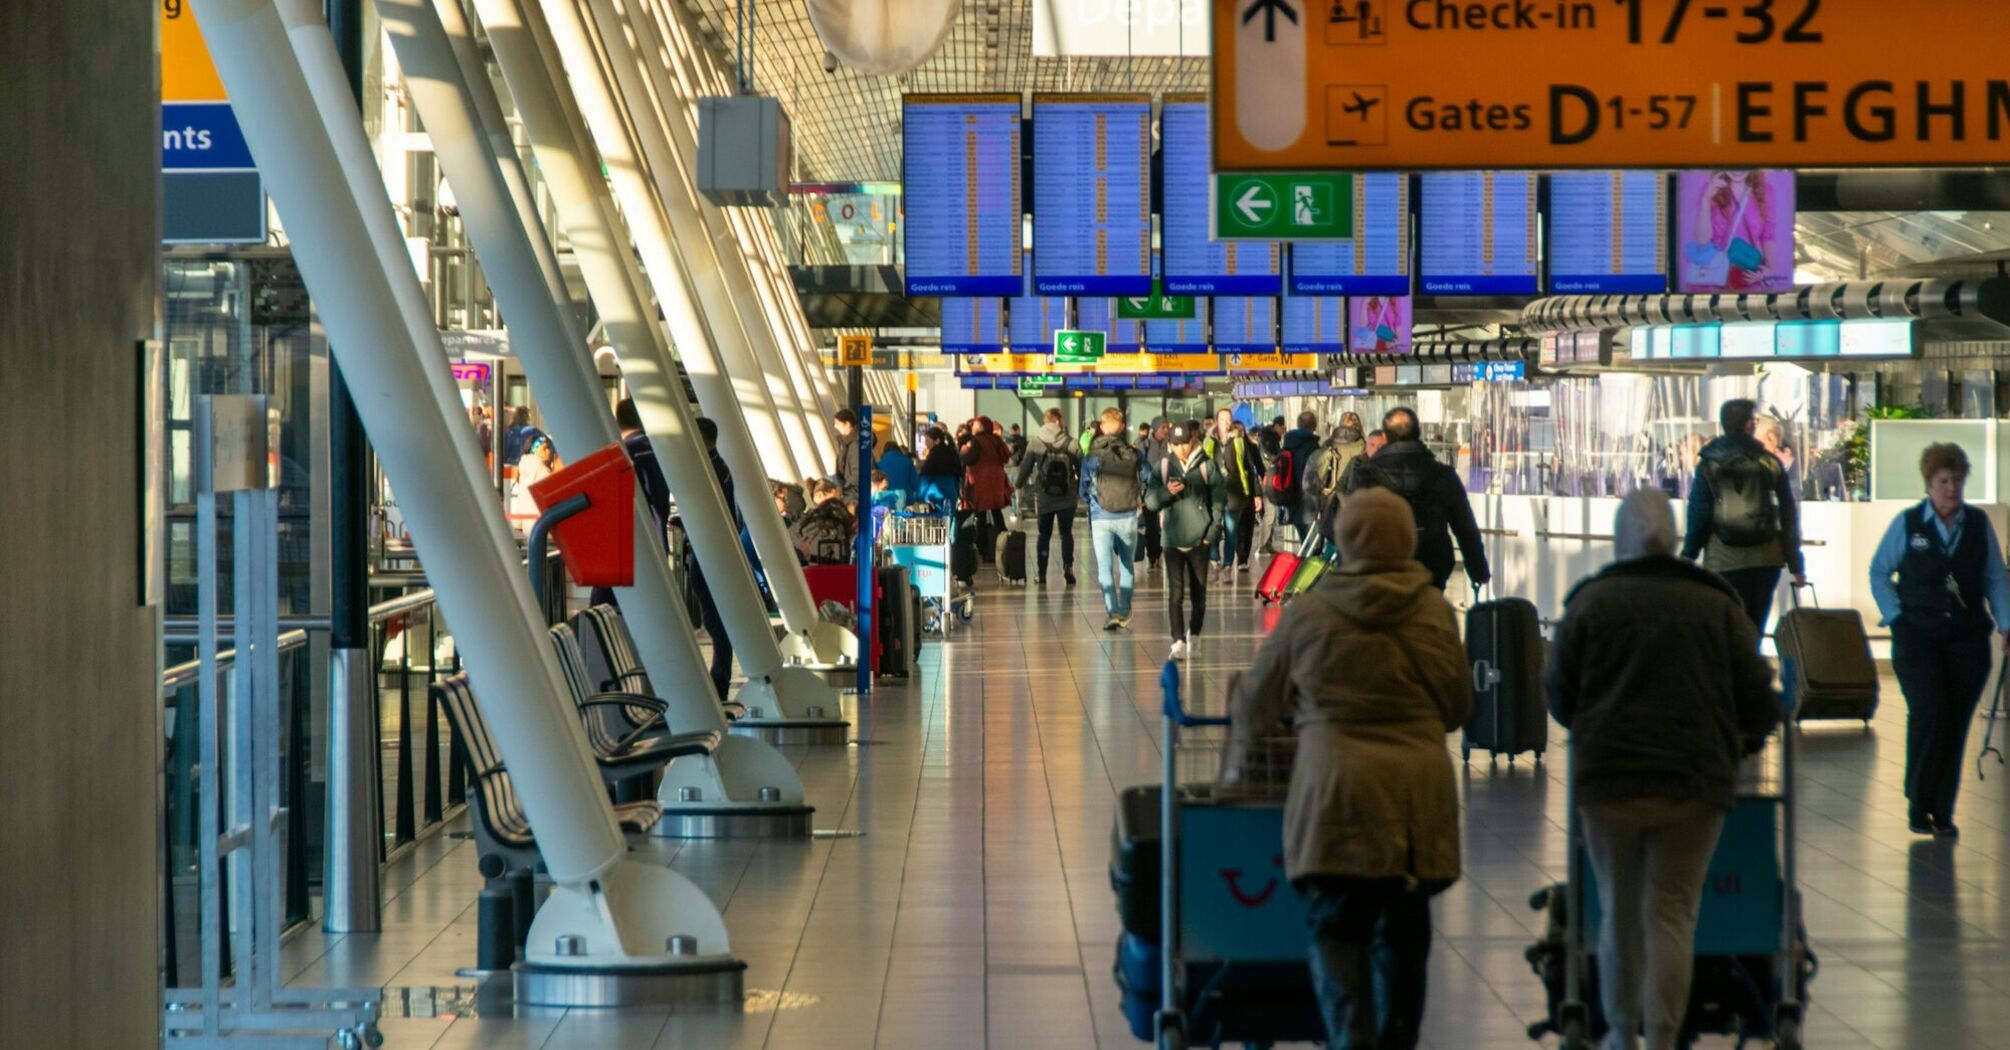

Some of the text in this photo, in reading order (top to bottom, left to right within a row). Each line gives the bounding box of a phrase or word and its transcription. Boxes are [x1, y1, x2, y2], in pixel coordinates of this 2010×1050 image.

[1406, 0, 1823, 44] Check-in 17-32
[1405, 96, 1532, 131] Gates
[911, 283, 956, 291] Goede reis
[1040, 282, 1085, 291] Goede reis
[1169, 282, 1214, 290] Goede reis
[1297, 282, 1342, 290] Goede reis
[1426, 282, 1471, 290] Goede reis
[1555, 282, 1600, 290] Goede reis
[1280, 353, 1293, 365] M
